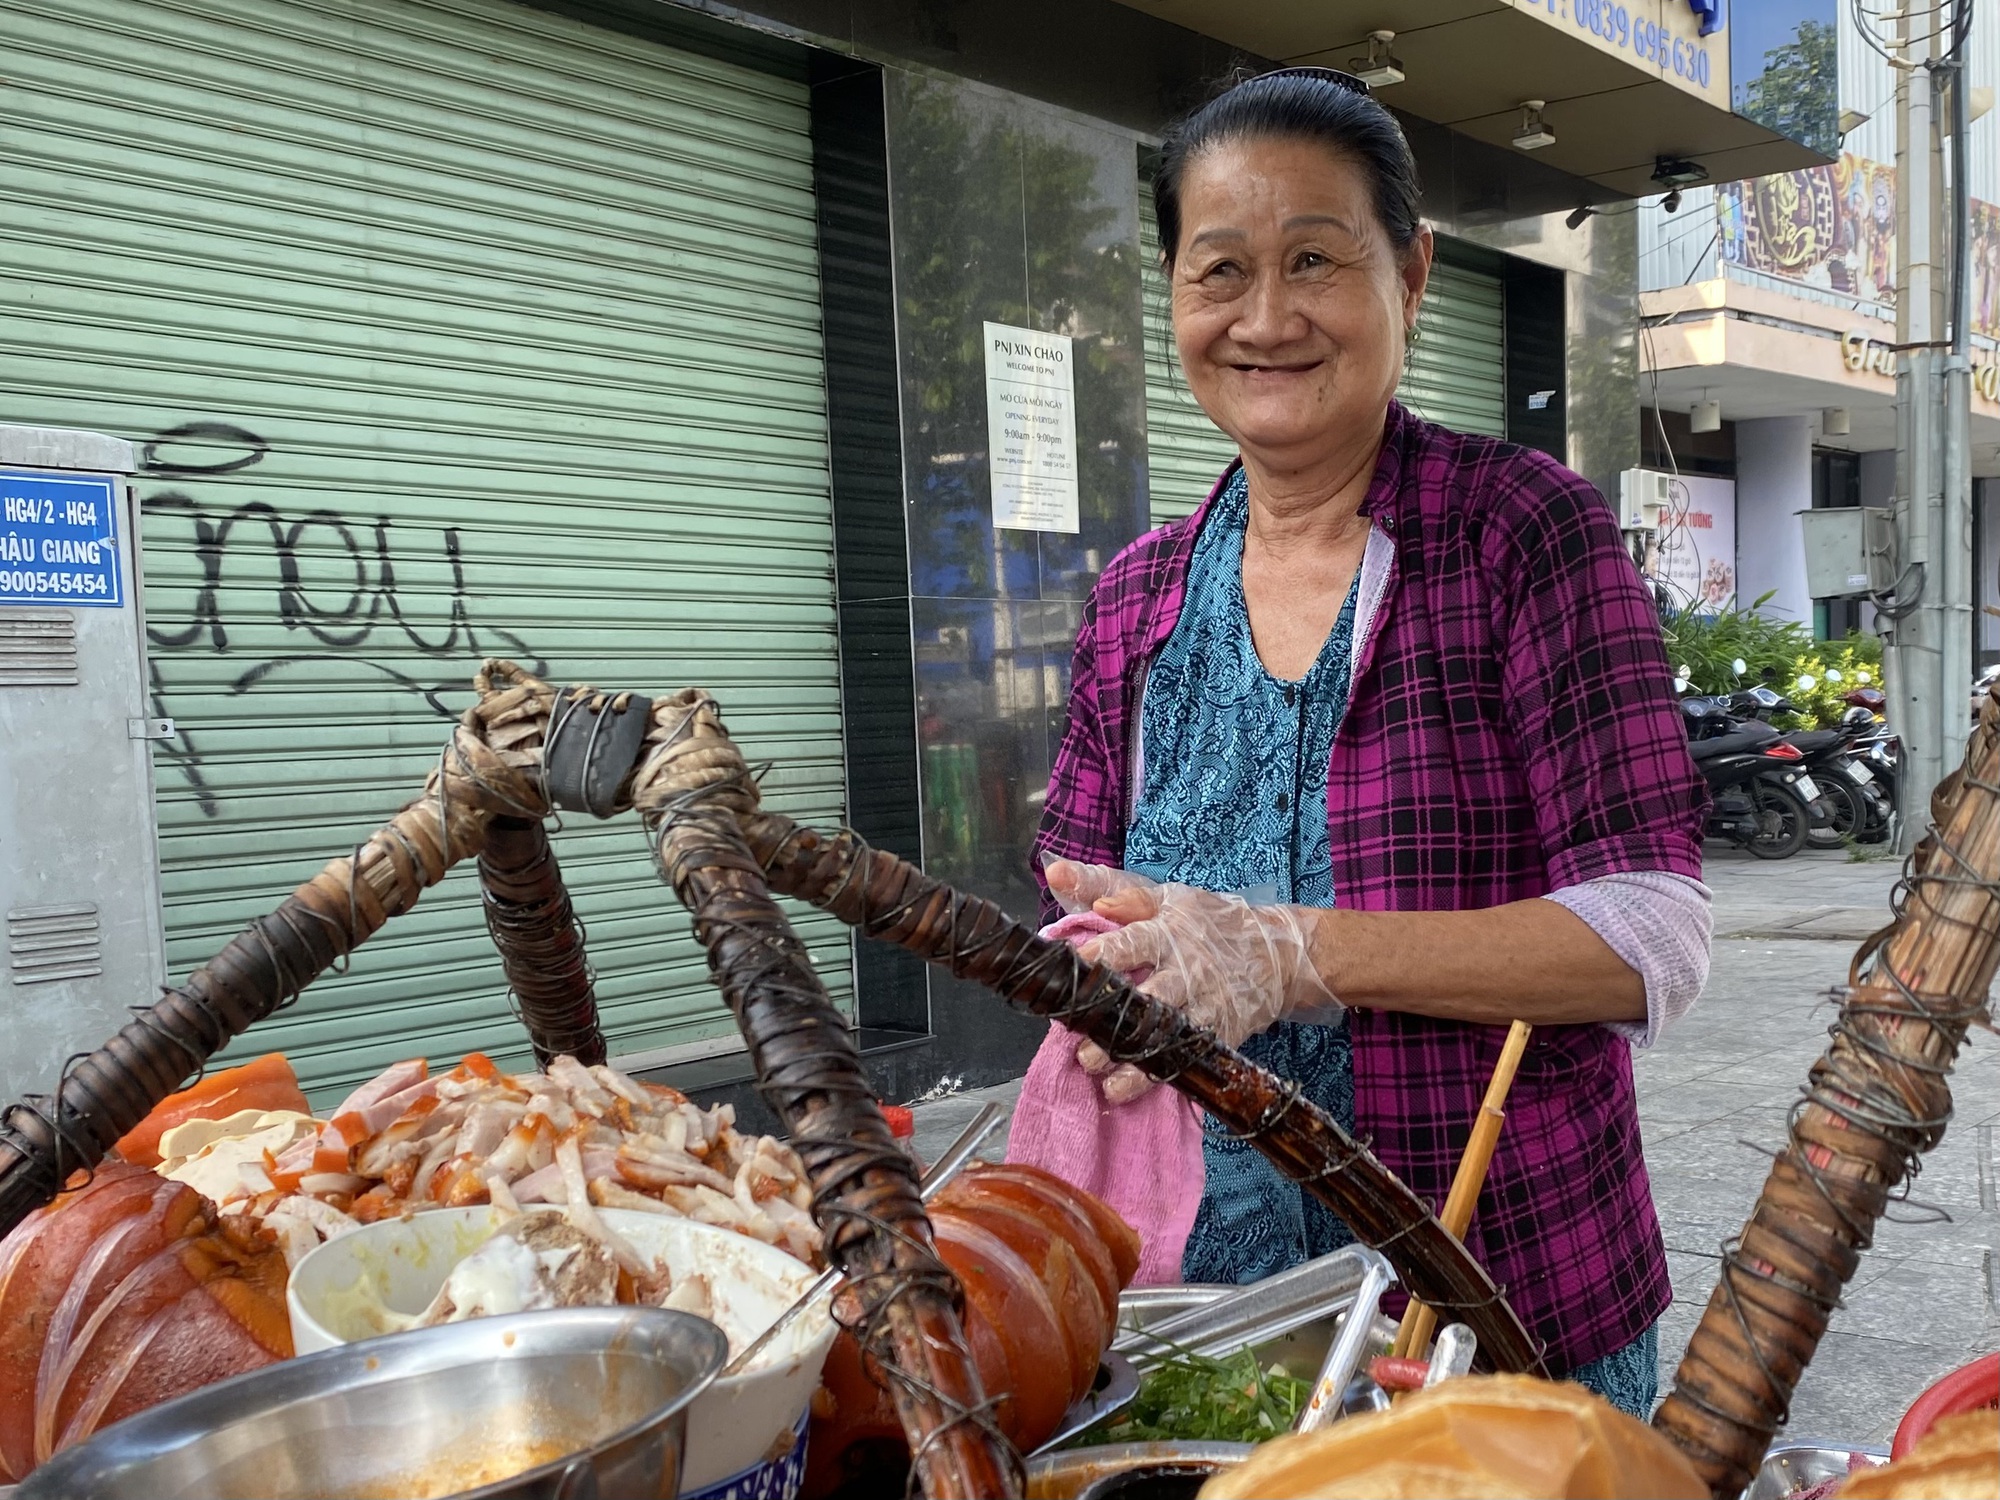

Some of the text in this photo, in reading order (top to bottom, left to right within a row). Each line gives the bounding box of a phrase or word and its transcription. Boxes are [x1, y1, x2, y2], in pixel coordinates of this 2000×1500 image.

[1633, 17, 1670, 69] 695
[1673, 37, 1710, 89] 630
[994, 339, 1064, 363] PNJ XIN CHÀO
[1006, 361, 1055, 377] WELCOME TO PNJ
[1005, 411, 1060, 425] OPENING EVERYDAY
[1004, 428, 1030, 440] 9:00am
[1036, 432, 1062, 446] 9:00pm
[42, 538, 101, 565] GIANG
